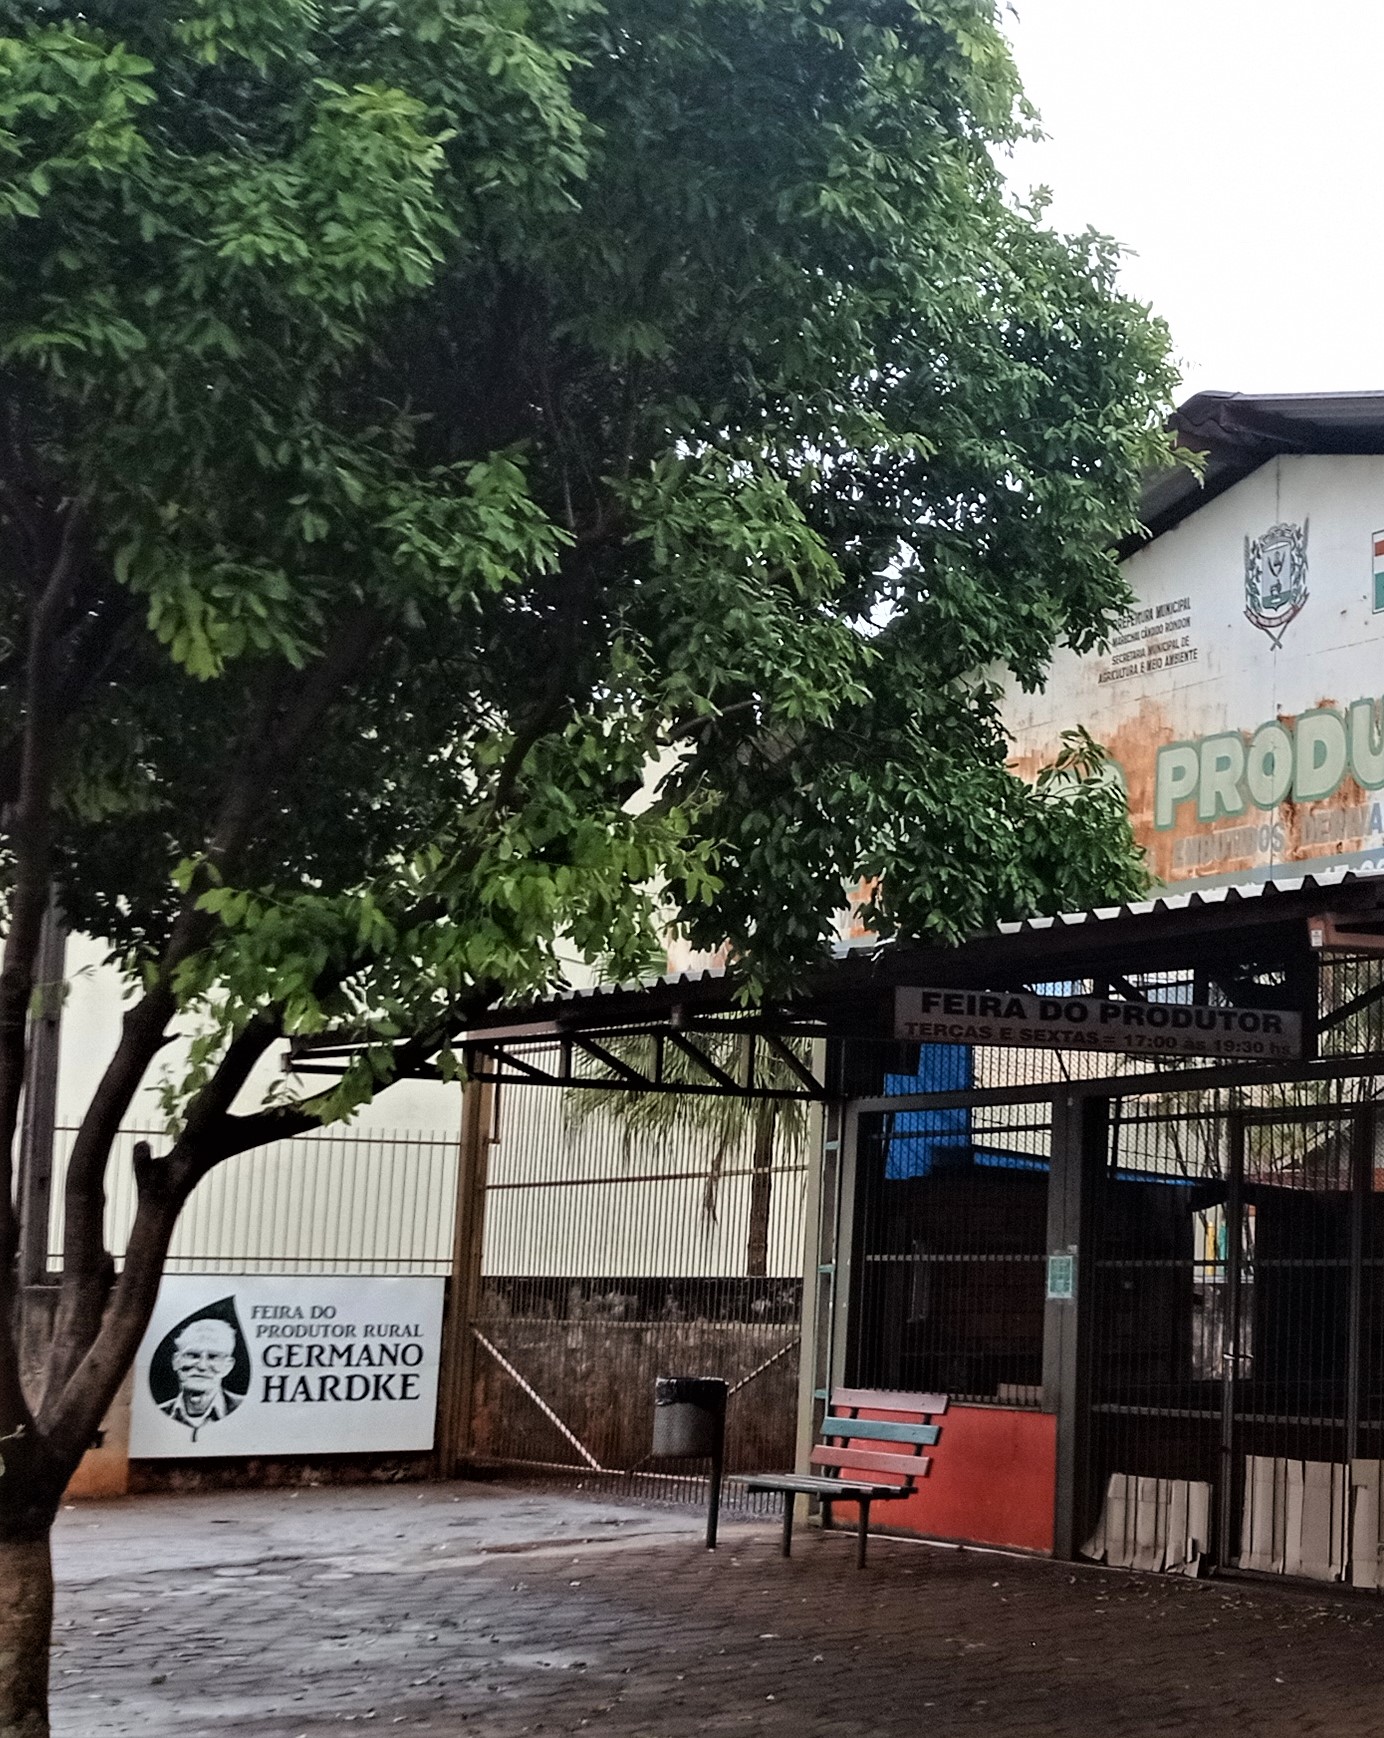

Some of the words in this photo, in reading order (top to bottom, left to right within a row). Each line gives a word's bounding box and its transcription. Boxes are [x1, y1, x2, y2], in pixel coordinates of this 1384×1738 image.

[1156, 597, 1191, 618] MUNICIPAL
[1147, 639, 1179, 656] MUNICIPAL
[1181, 635, 1190, 647] DE
[1147, 658, 1162, 671] MEIO
[1165, 648, 1198, 666] AMBIENTE
[921, 991, 1027, 1020] FEIRA
[1039, 1000, 1089, 1023] DO
[1101, 1003, 1283, 1035] PRODUTOR
[1002, 1027, 1014, 1041] E
[1124, 1034, 1177, 1049] 17:00
[1214, 1039, 1263, 1054] 19:30
[250, 1305, 304, 1319] FEIRA
[310, 1305, 337, 1319] DO
[256, 1324, 357, 1338] PRODUTOR
[363, 1324, 423, 1338] RURAL
[262, 1343, 424, 1368] GERMANO
[260, 1373, 421, 1403] HARDKE
